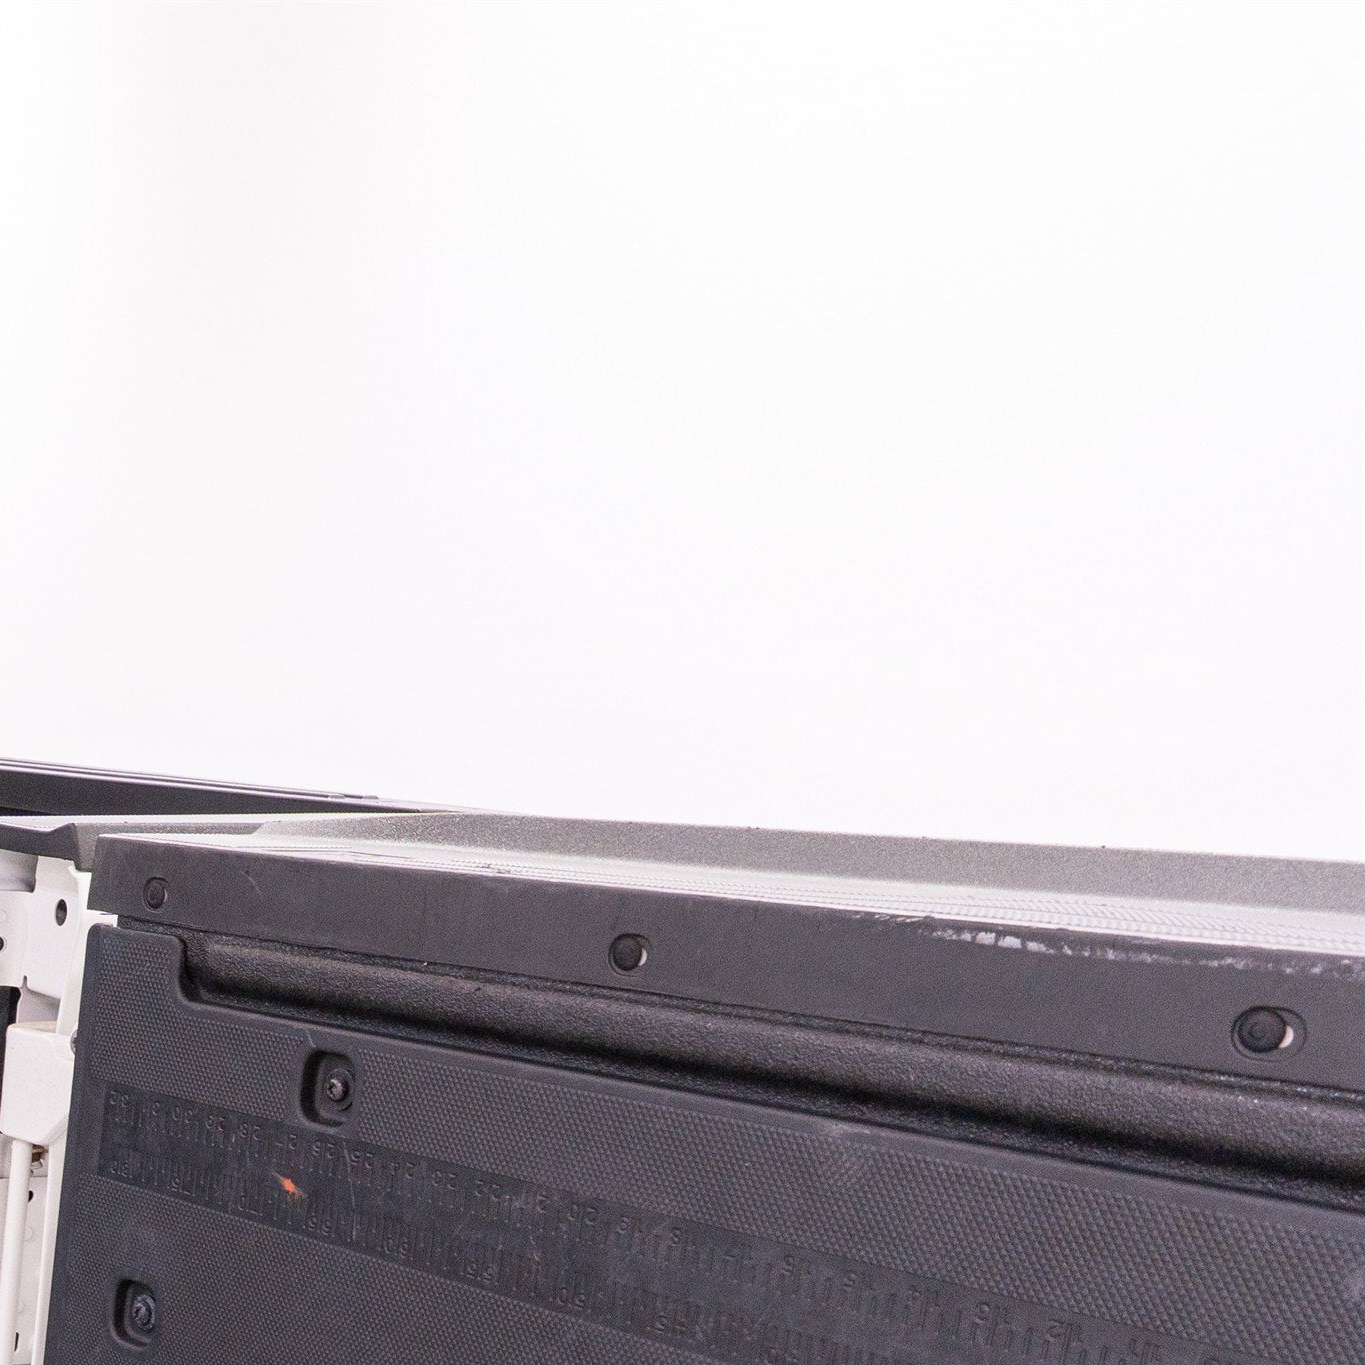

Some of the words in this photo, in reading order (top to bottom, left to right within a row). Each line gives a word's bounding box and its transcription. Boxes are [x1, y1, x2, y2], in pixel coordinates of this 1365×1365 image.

[108, 1090, 130, 1108] 32
[172, 1105, 193, 1124] 30
[350, 1151, 373, 1169] 25
[474, 1179, 500, 1203] 22
[567, 1203, 598, 1226] 20
[465, 1262, 493, 1281] 55
[556, 1288, 586, 1308] 50
[1044, 1318, 1082, 1344] 12
